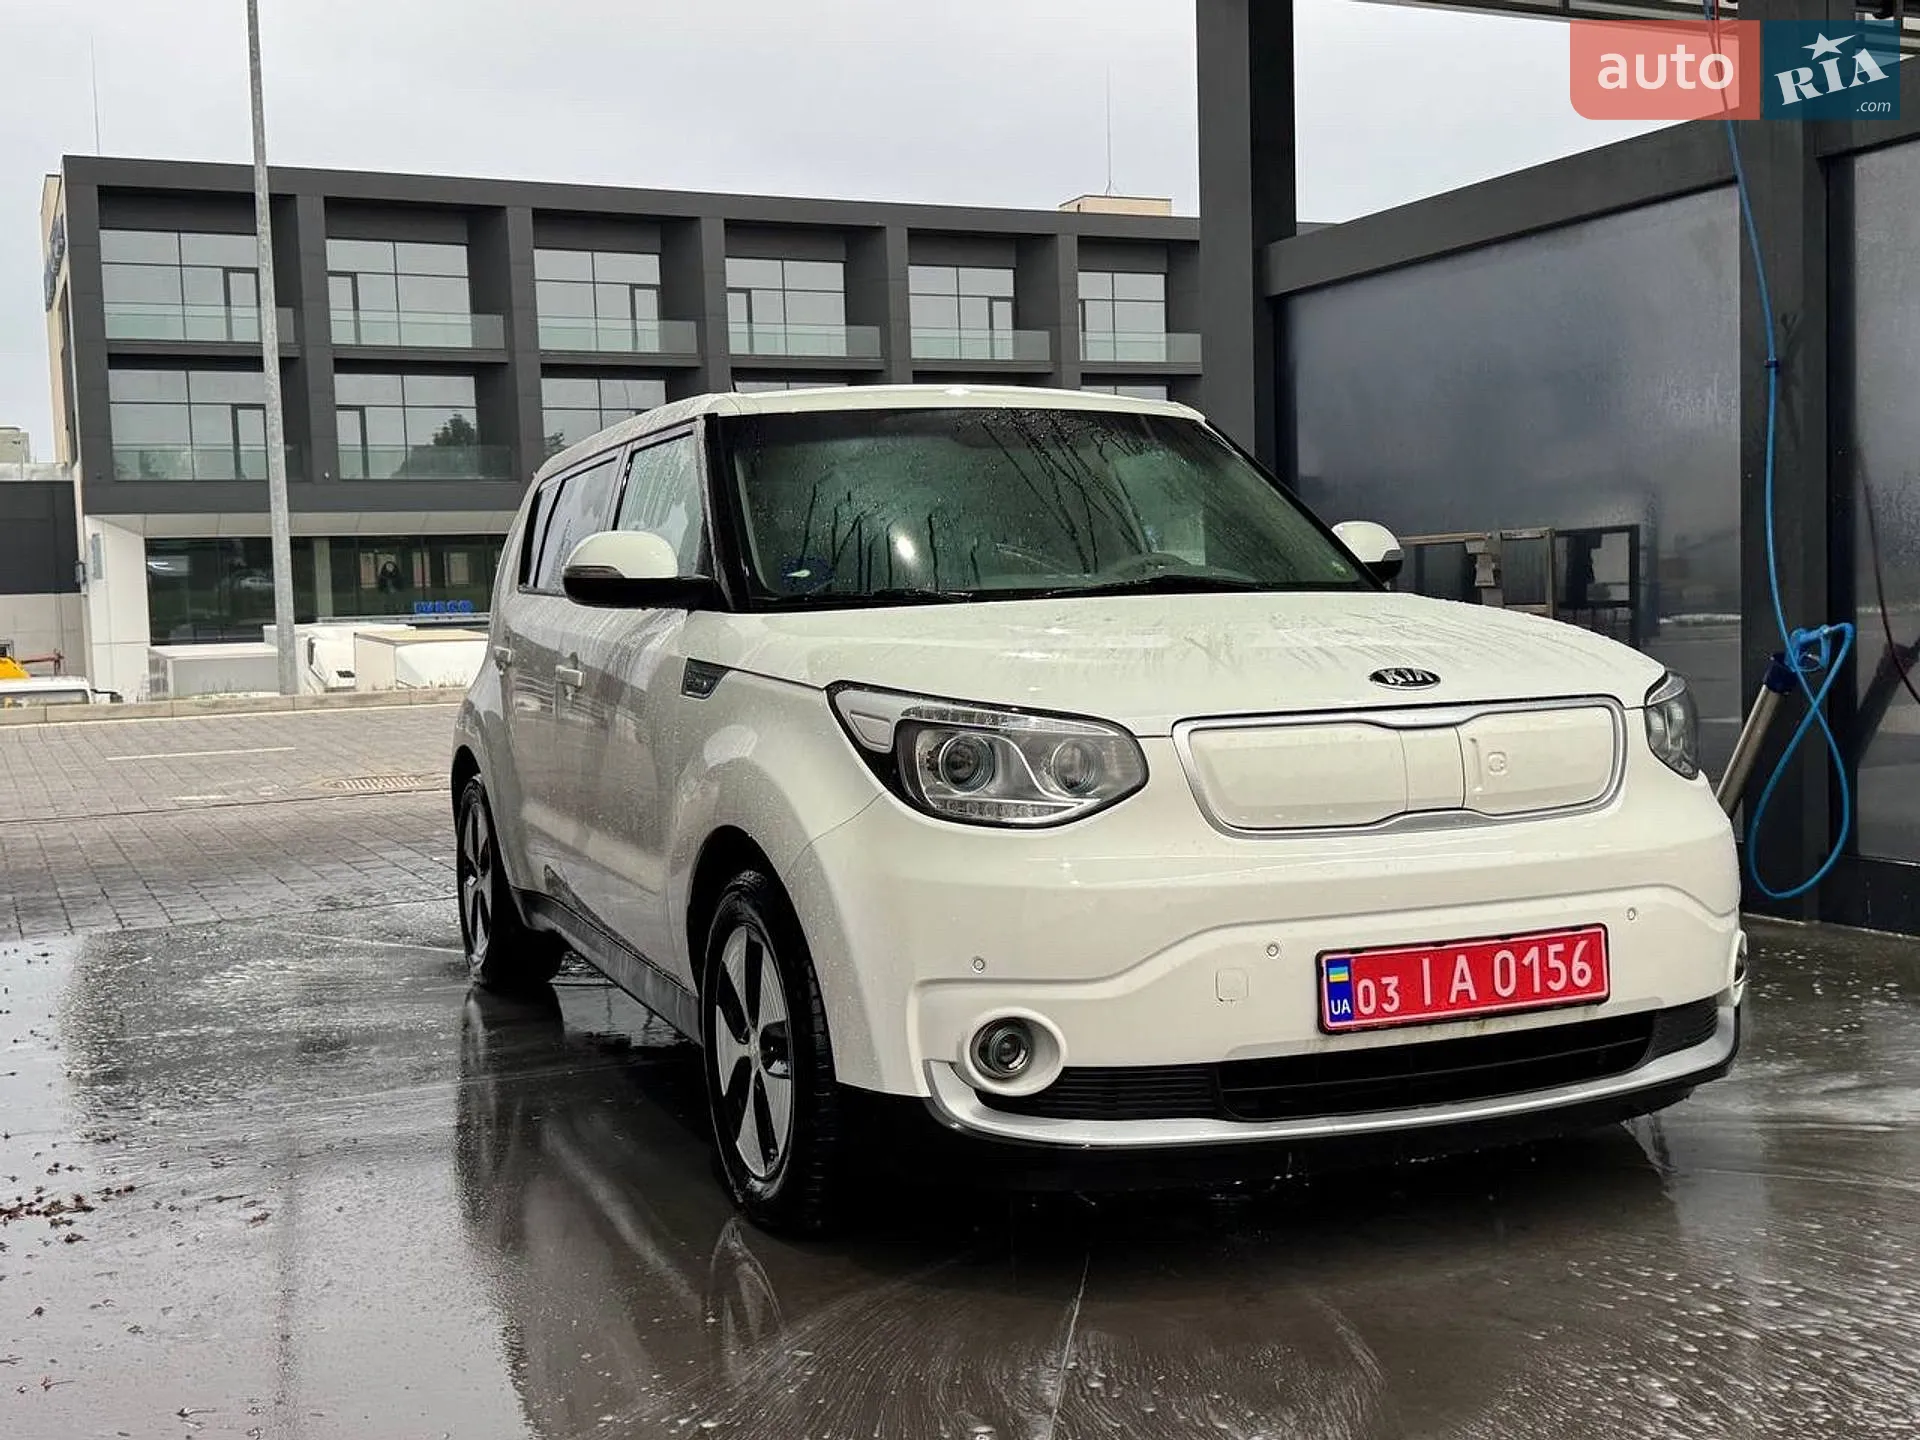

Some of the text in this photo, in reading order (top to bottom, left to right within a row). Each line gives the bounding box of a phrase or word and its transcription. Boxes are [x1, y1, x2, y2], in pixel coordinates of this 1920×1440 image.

[1356, 940, 1593, 1016] 03 IA 0156
[1331, 998, 1351, 1016] UA
